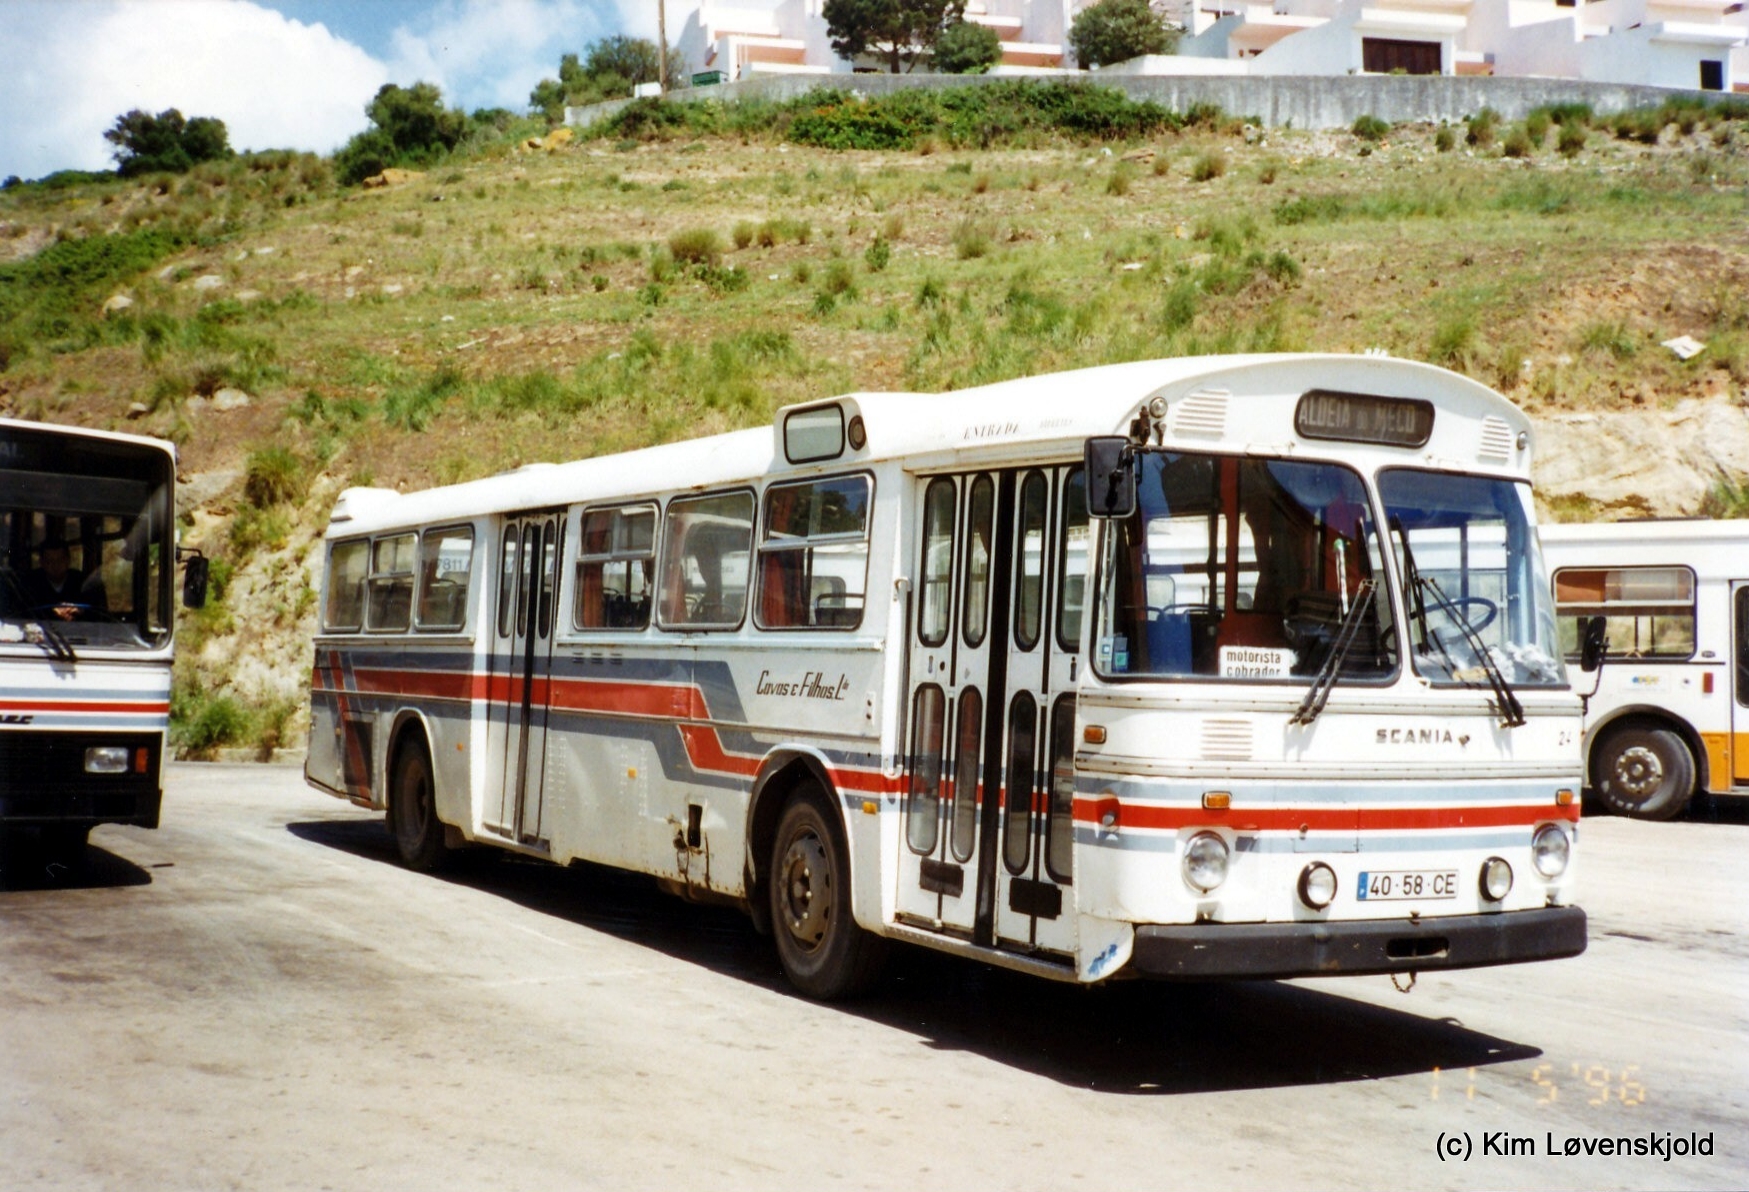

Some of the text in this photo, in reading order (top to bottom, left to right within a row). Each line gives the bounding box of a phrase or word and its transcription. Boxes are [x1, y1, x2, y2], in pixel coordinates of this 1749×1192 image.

[1298, 396, 1351, 429] ALDEIA
[1226, 649, 1282, 664] motorista
[1226, 665, 1281, 678] cobrador
[1376, 728, 1453, 744] SCANIA
